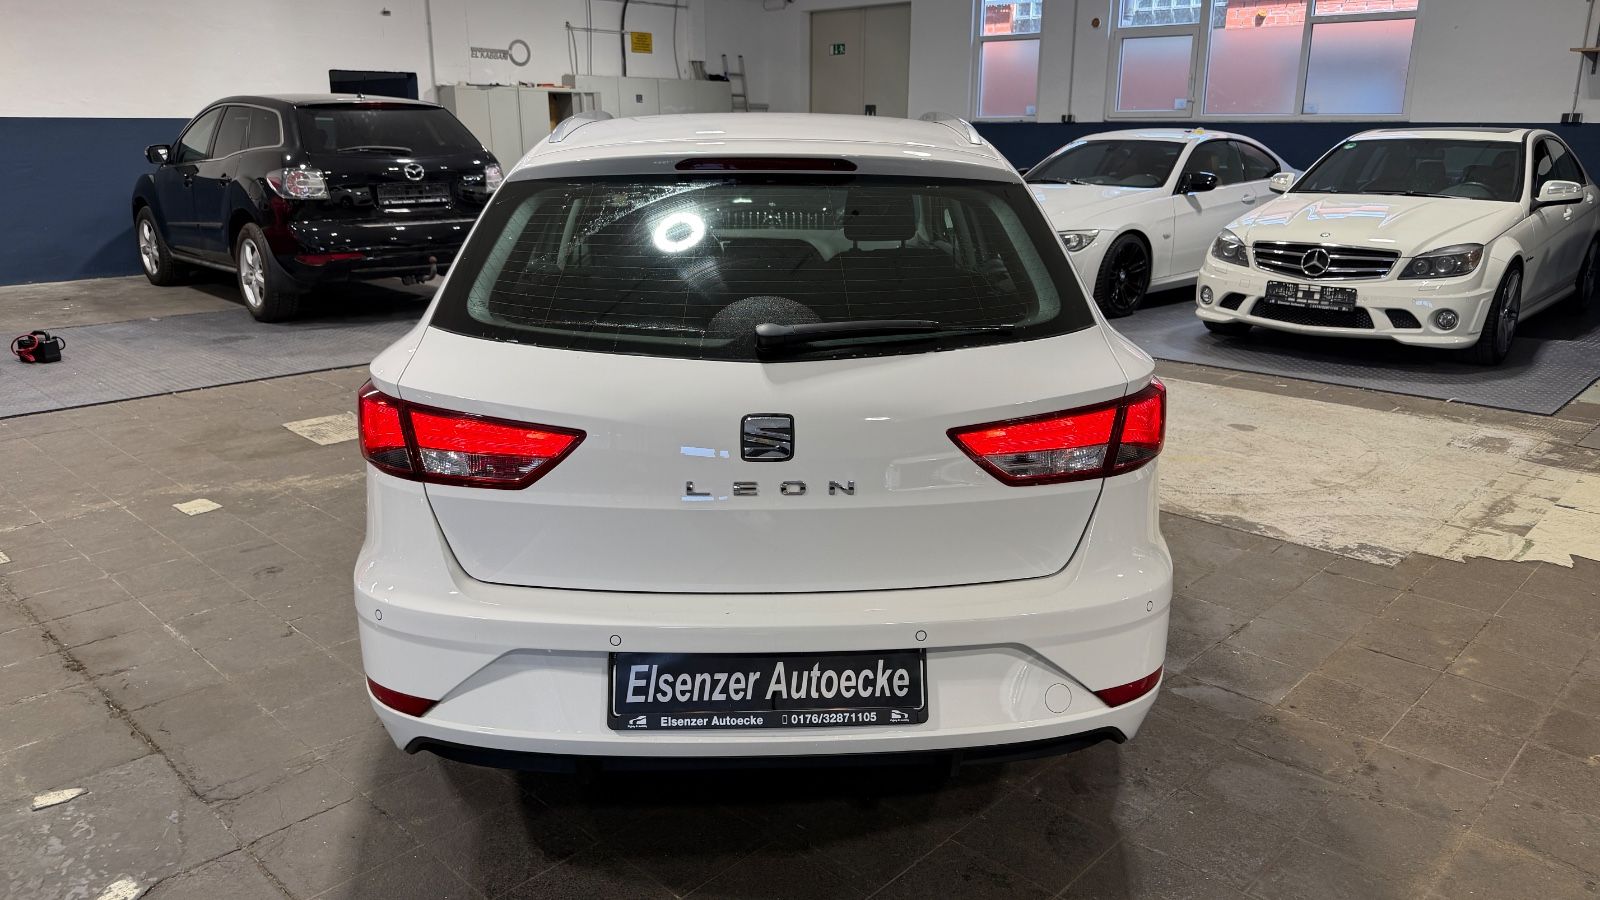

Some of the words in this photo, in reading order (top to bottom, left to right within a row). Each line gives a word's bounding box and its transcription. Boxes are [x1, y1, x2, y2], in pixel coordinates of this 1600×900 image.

[686, 480, 855, 496] LEON
[626, 664, 760, 703] Elsenzer
[765, 659, 910, 699] Autoecke
[660, 716, 708, 726] Elsenzer
[711, 715, 764, 726] Autoecke
[791, 712, 877, 724] 0176/32871105
